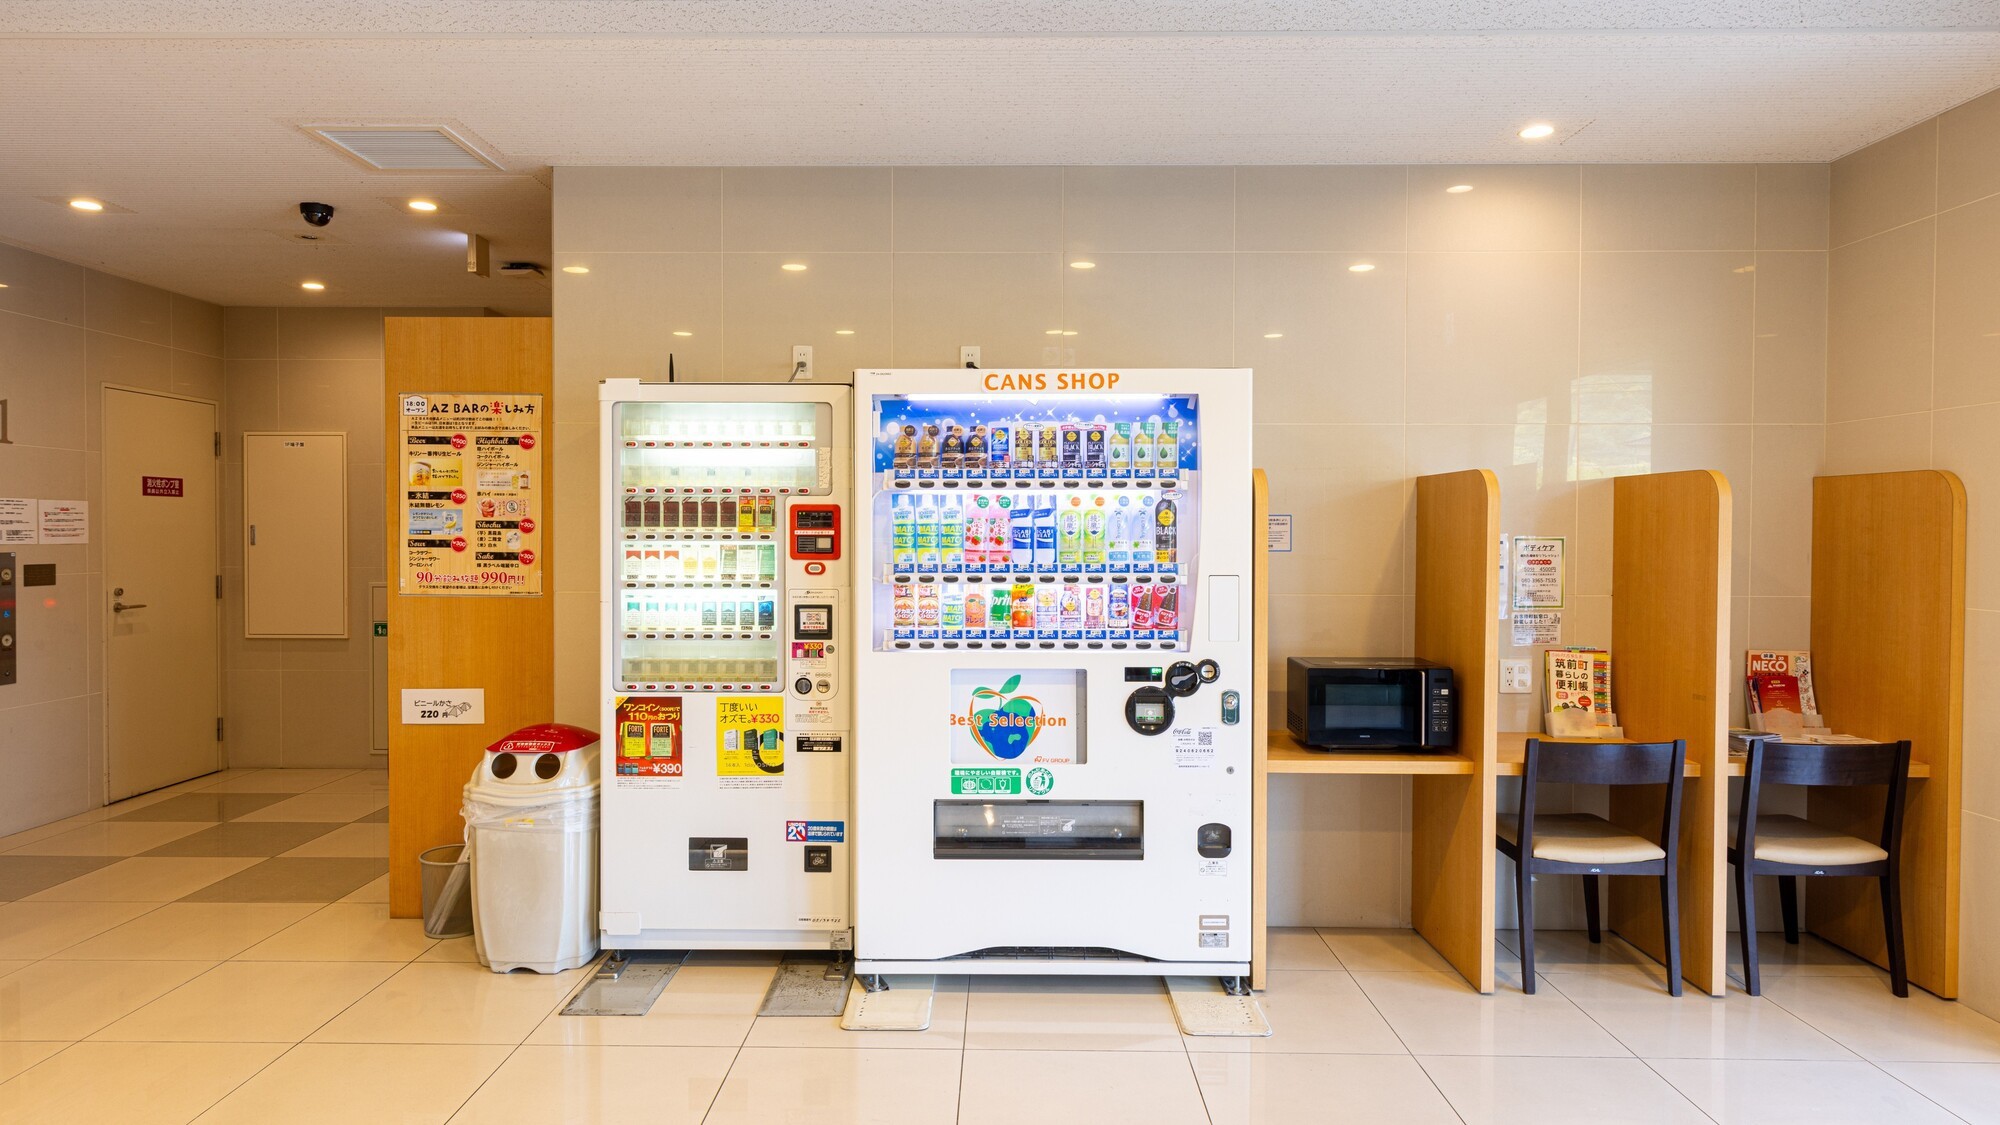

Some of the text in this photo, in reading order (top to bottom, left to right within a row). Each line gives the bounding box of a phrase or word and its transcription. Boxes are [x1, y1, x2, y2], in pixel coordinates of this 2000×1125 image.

[984, 372, 1120, 391] CANS SHOP
[431, 401, 535, 415] AZ BARの楽しみ方
[477, 437, 509, 445] Highball
[1156, 526, 1176, 535] BLACK
[416, 571, 478, 584] 90分飲み放題
[1555, 657, 1588, 671] 筑前町
[1752, 660, 1787, 672] NECO
[1555, 670, 1588, 680] 暮らしの
[1555, 679, 1589, 691] 便利帳
[414, 699, 452, 707] ビニールかさ
[719, 702, 758, 713] 丁度いい
[420, 710, 439, 718] 220
[628, 711, 681, 721] 110円のおつり
[950, 712, 1067, 727] Best Selection
[628, 724, 643, 733] FORTE
[653, 724, 669, 733] FORTE
[652, 763, 682, 774] ¥390
[787, 826, 806, 840] 20
